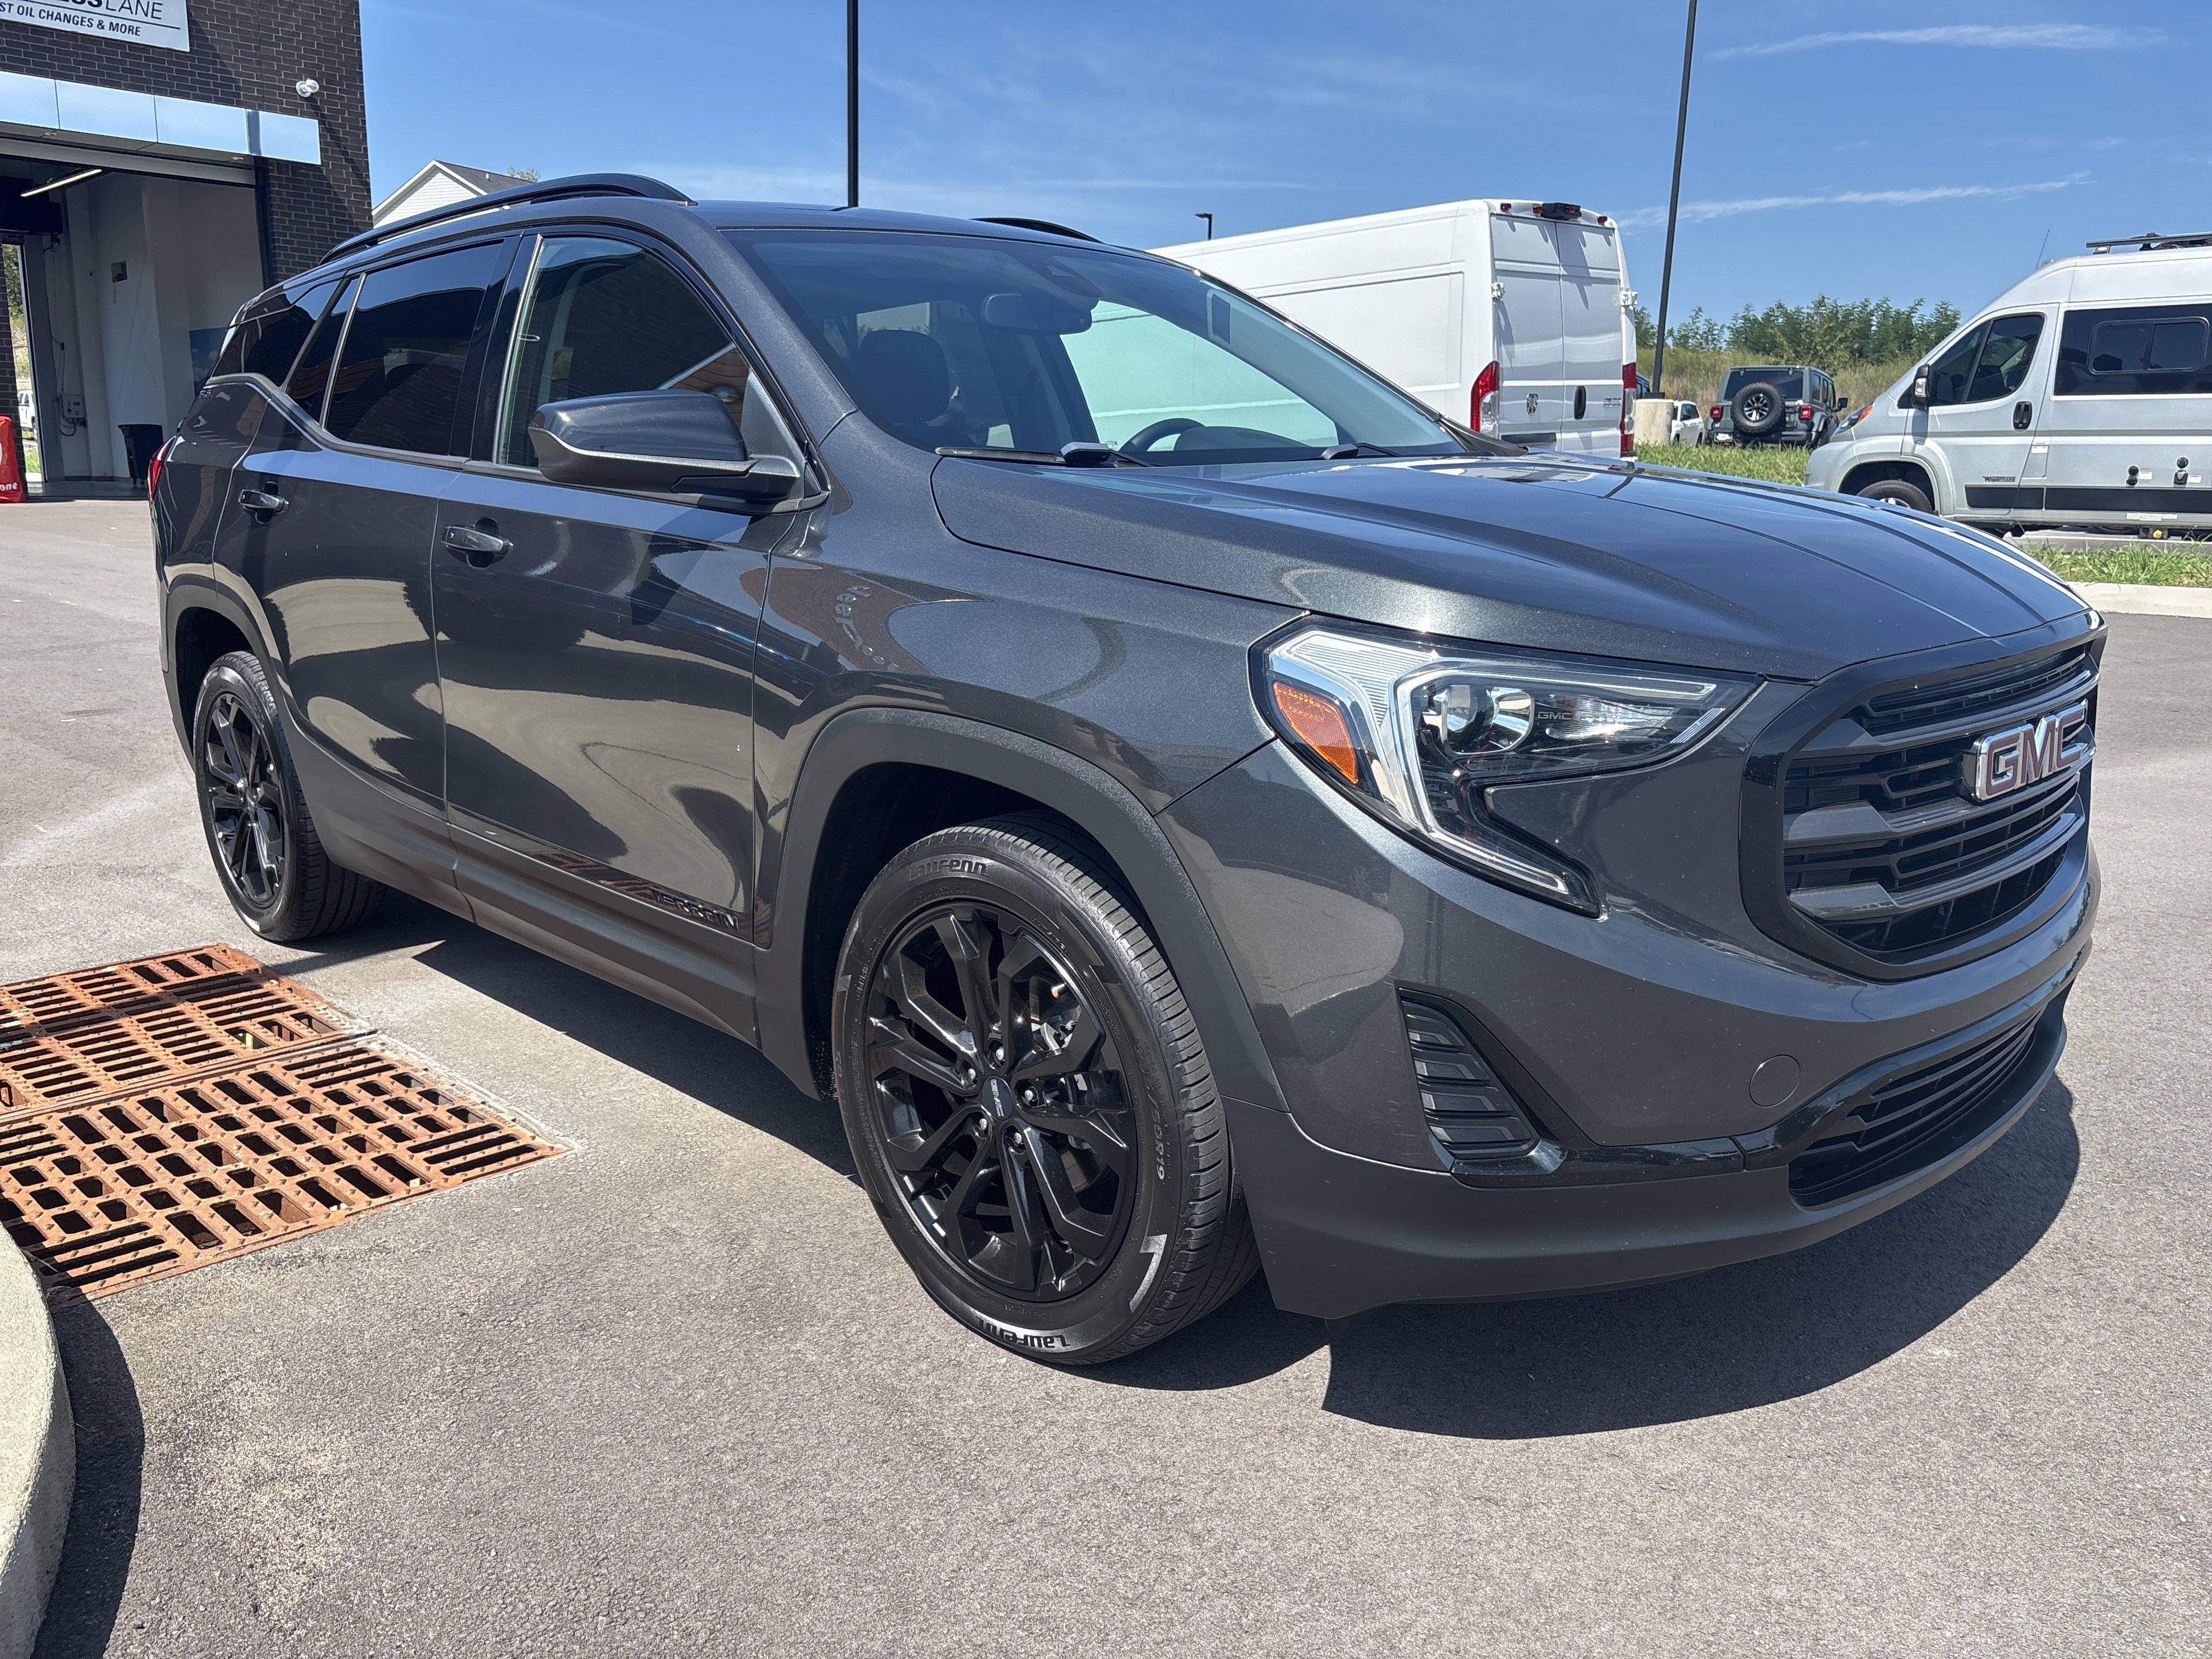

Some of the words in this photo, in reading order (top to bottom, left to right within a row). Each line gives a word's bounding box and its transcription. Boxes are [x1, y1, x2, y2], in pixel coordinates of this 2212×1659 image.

[17, 5, 35, 18] OIL
[38, 9, 93, 28] CHANGES
[97, 19, 105, 30] &
[109, 21, 141, 37] MORE
[1538, 712, 1572, 720] GMC
[1976, 698, 2088, 801] GMC
[648, 886, 739, 930] TERRAIN
[990, 1079, 1005, 1117] GMC
[975, 1316, 1071, 1348] Laufenn
